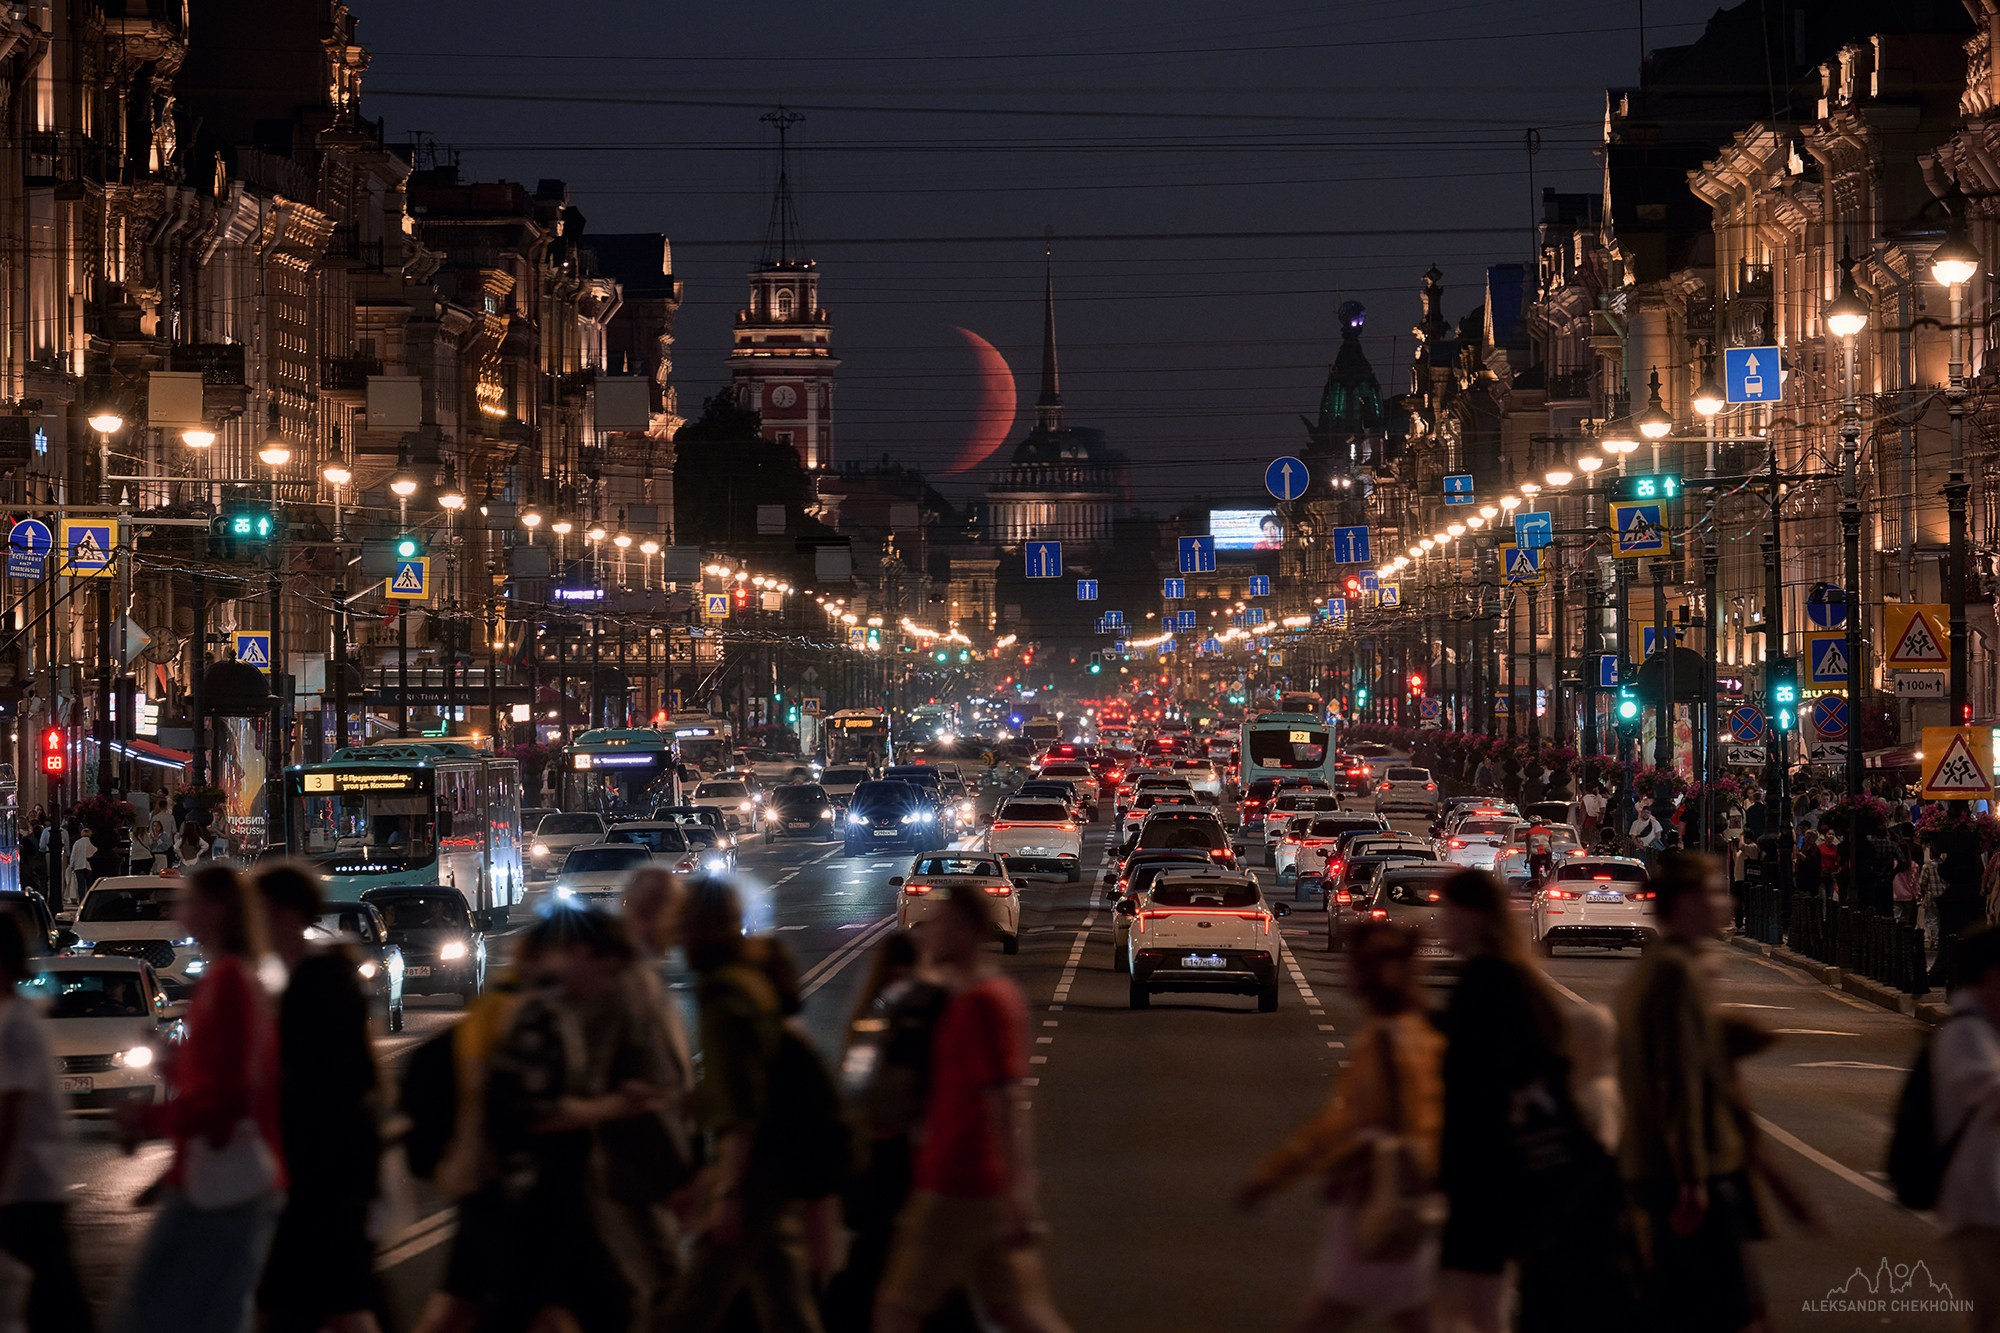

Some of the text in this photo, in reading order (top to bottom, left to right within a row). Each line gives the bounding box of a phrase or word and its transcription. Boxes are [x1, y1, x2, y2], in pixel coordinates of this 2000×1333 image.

[1638, 480, 1655, 496] 26
[235, 519, 250, 532] 26
[1906, 680, 1933, 690] 100м
[394, 693, 439, 701] CRINTHIA
[1777, 686, 1794, 702] 26
[1295, 733, 1305, 741] 22
[47, 756, 62, 769] 68
[315, 777, 323, 788] 3
[336, 774, 349, 782] 5-й
[349, 773, 398, 783] Предпортовый
[342, 783, 359, 791] угол
[228, 816, 266, 826] ЛЮБИТЬ
